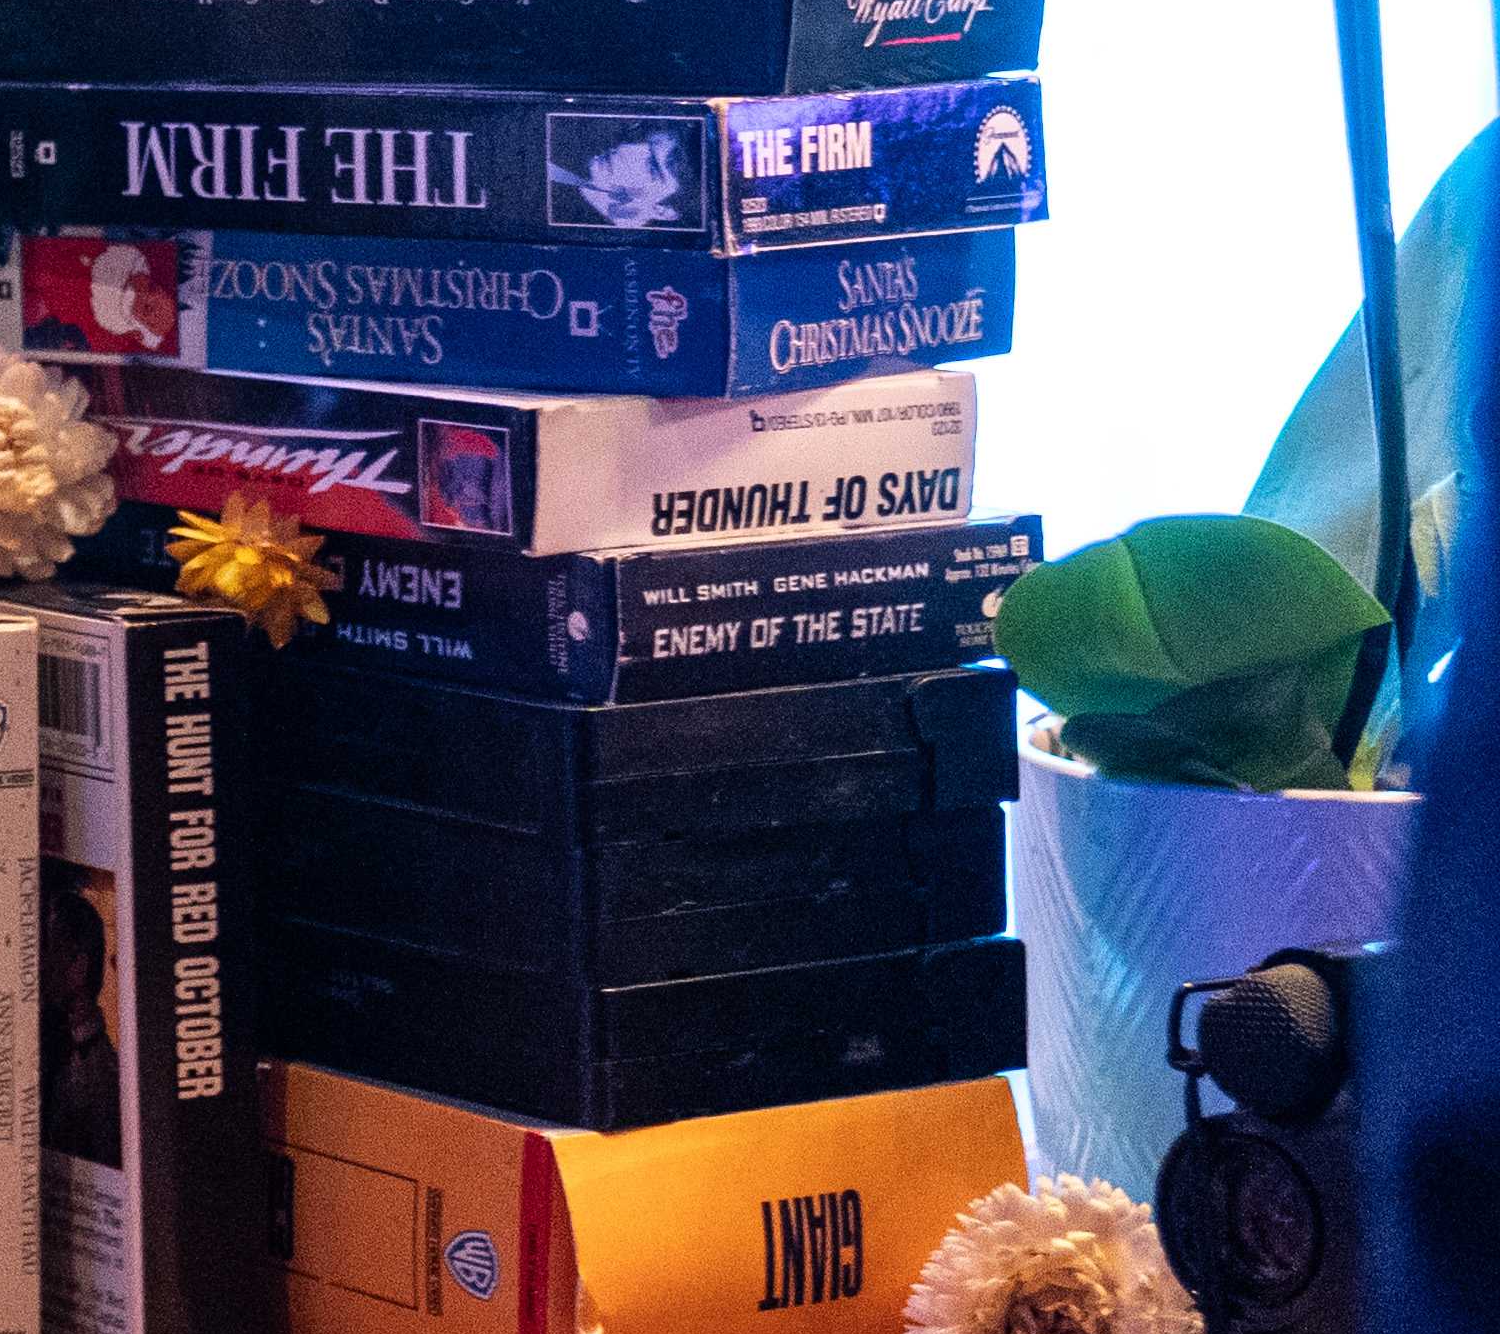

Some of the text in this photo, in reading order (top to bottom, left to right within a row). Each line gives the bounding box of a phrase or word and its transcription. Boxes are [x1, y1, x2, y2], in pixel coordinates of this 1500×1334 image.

[120, 119, 489, 210] THE FIRM
[737, 121, 873, 180] THE FIRM
[192, 257, 565, 319] CHRISTMAS SNOOZ
[837, 255, 919, 312] SANTA'S
[307, 312, 444, 367] SANTA'S
[769, 289, 984, 373] CHRISTMAS SNOOZE
[652, 466, 962, 537] DAYS OF THUNDER
[357, 557, 465, 610] ENEMY
[643, 587, 691, 605] WILL
[696, 578, 759, 602] SMITH
[773, 571, 828, 594] GENE
[833, 562, 930, 587] HACKMAN
[335, 622, 474, 660] WILL SMITH
[652, 618, 743, 659] ENEMY
[749, 617, 786, 649] OF
[792, 612, 842, 645] THE
[851, 604, 926, 639] STATE
[162, 640, 225, 1101] THE HUNT FOR RED OCTOBER
[758, 1188, 864, 1313] GIANT
